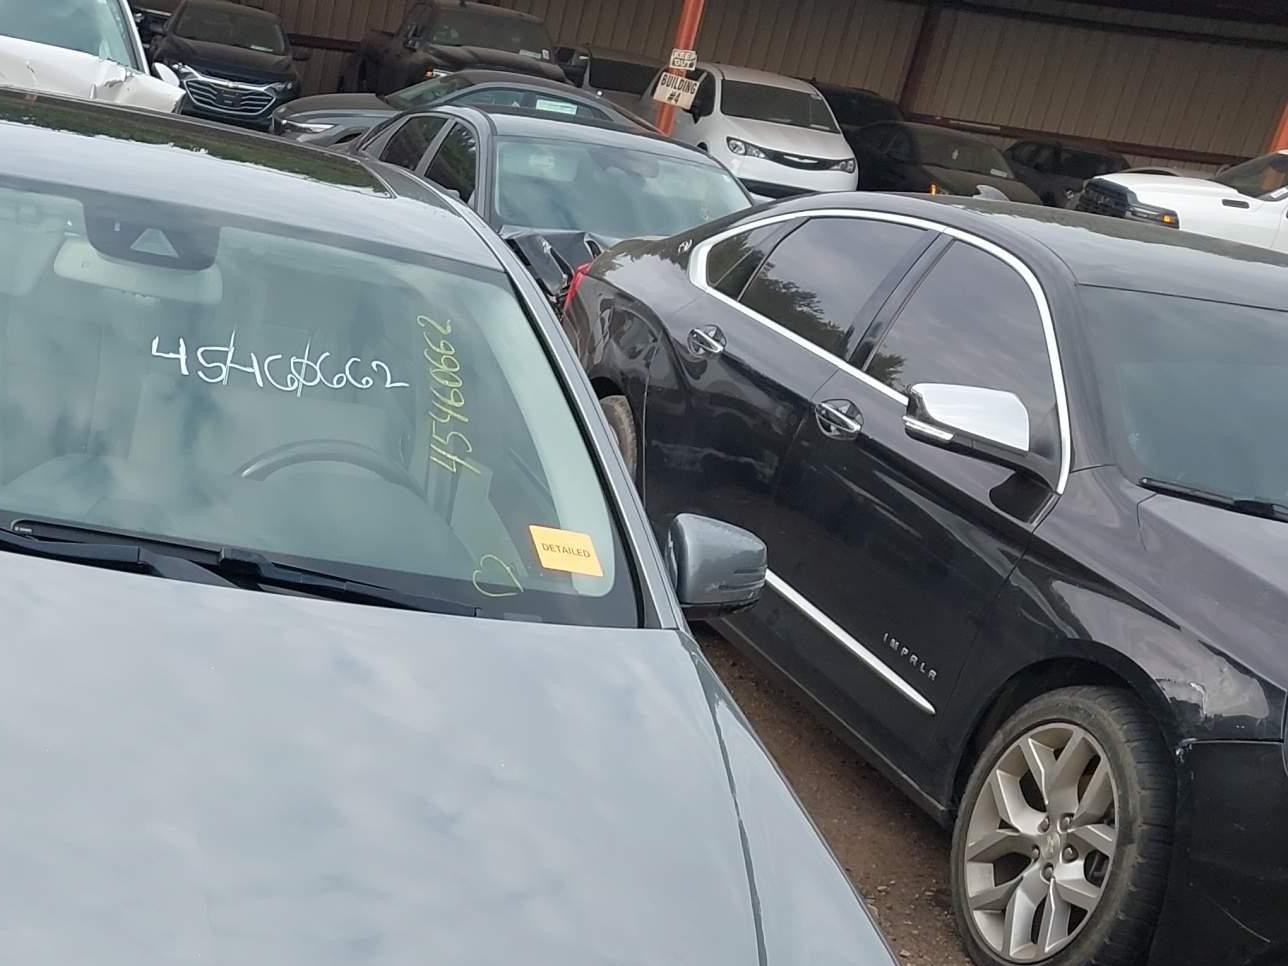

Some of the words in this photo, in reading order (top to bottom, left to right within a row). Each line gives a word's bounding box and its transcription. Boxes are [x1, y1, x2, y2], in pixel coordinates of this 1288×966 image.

[661, 74, 698, 95] BUILDING
[667, 90, 681, 104] #4
[150, 328, 410, 398] 45460662
[416, 314, 481, 474] 45460662
[541, 542, 591, 559] DETAILED
[883, 632, 937, 681] IMPALA
